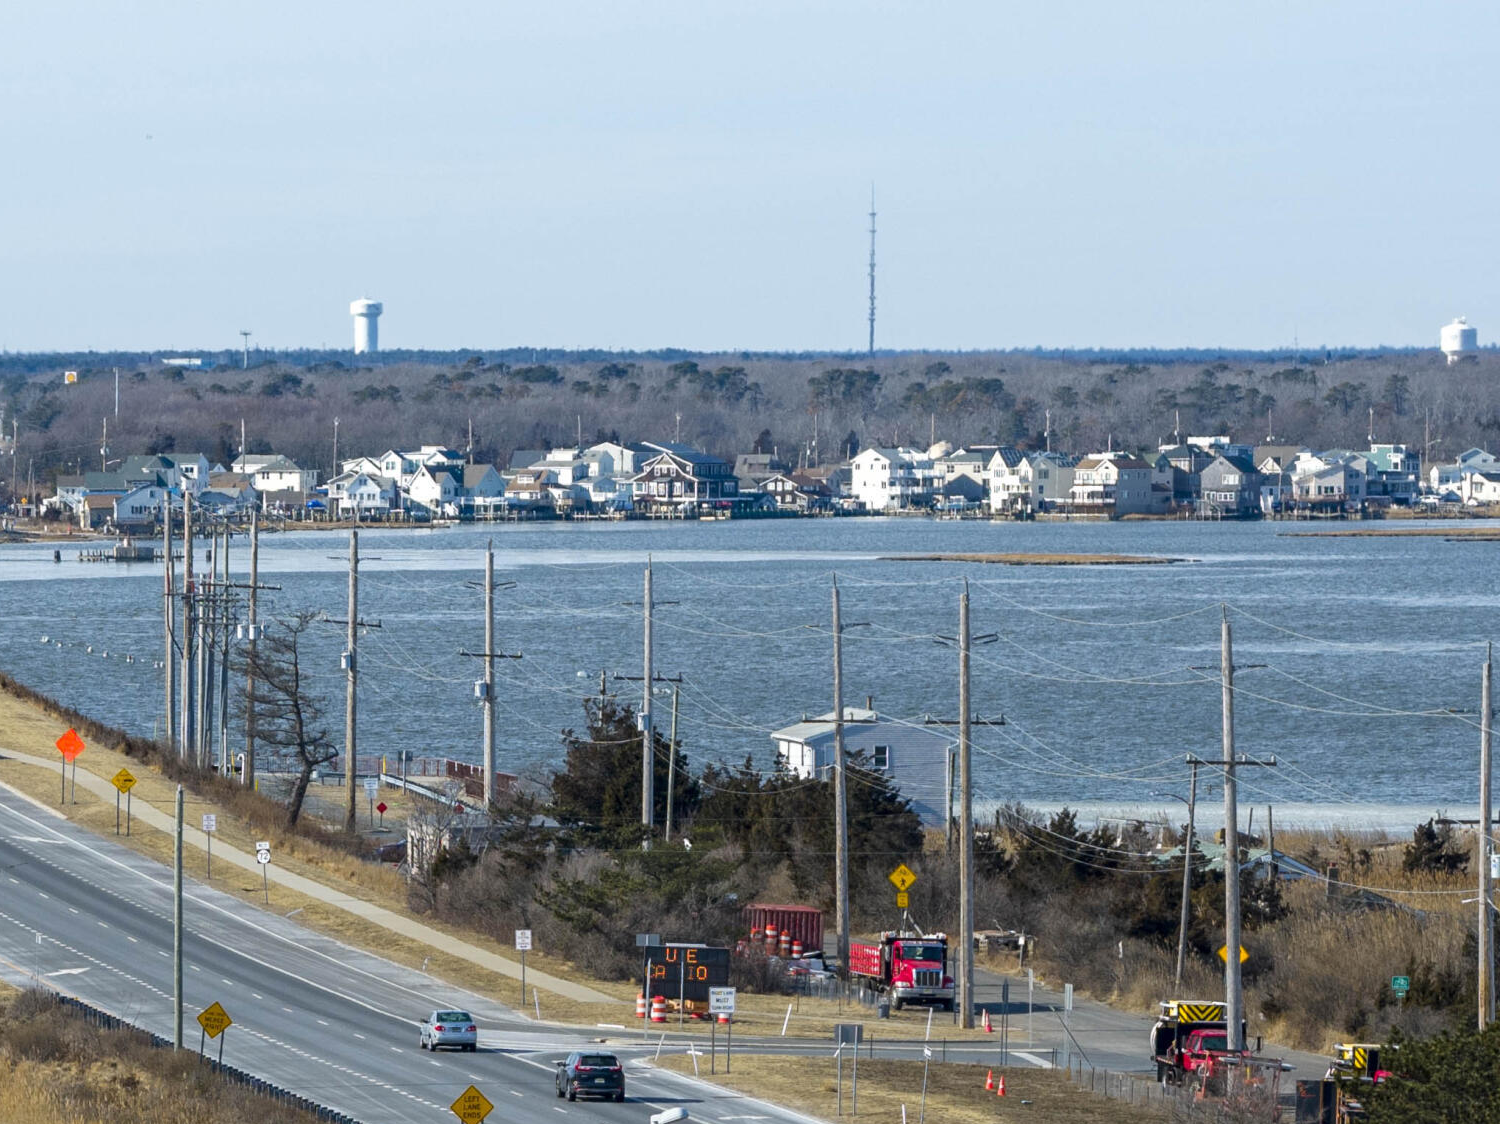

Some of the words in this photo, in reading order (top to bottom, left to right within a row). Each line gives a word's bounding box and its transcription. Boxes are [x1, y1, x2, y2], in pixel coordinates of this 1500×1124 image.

[260, 852, 269, 861] 72
[463, 1095, 480, 1103] LEFT
[463, 1103, 481, 1111] LANE
[463, 1111, 482, 1119] ENDS
